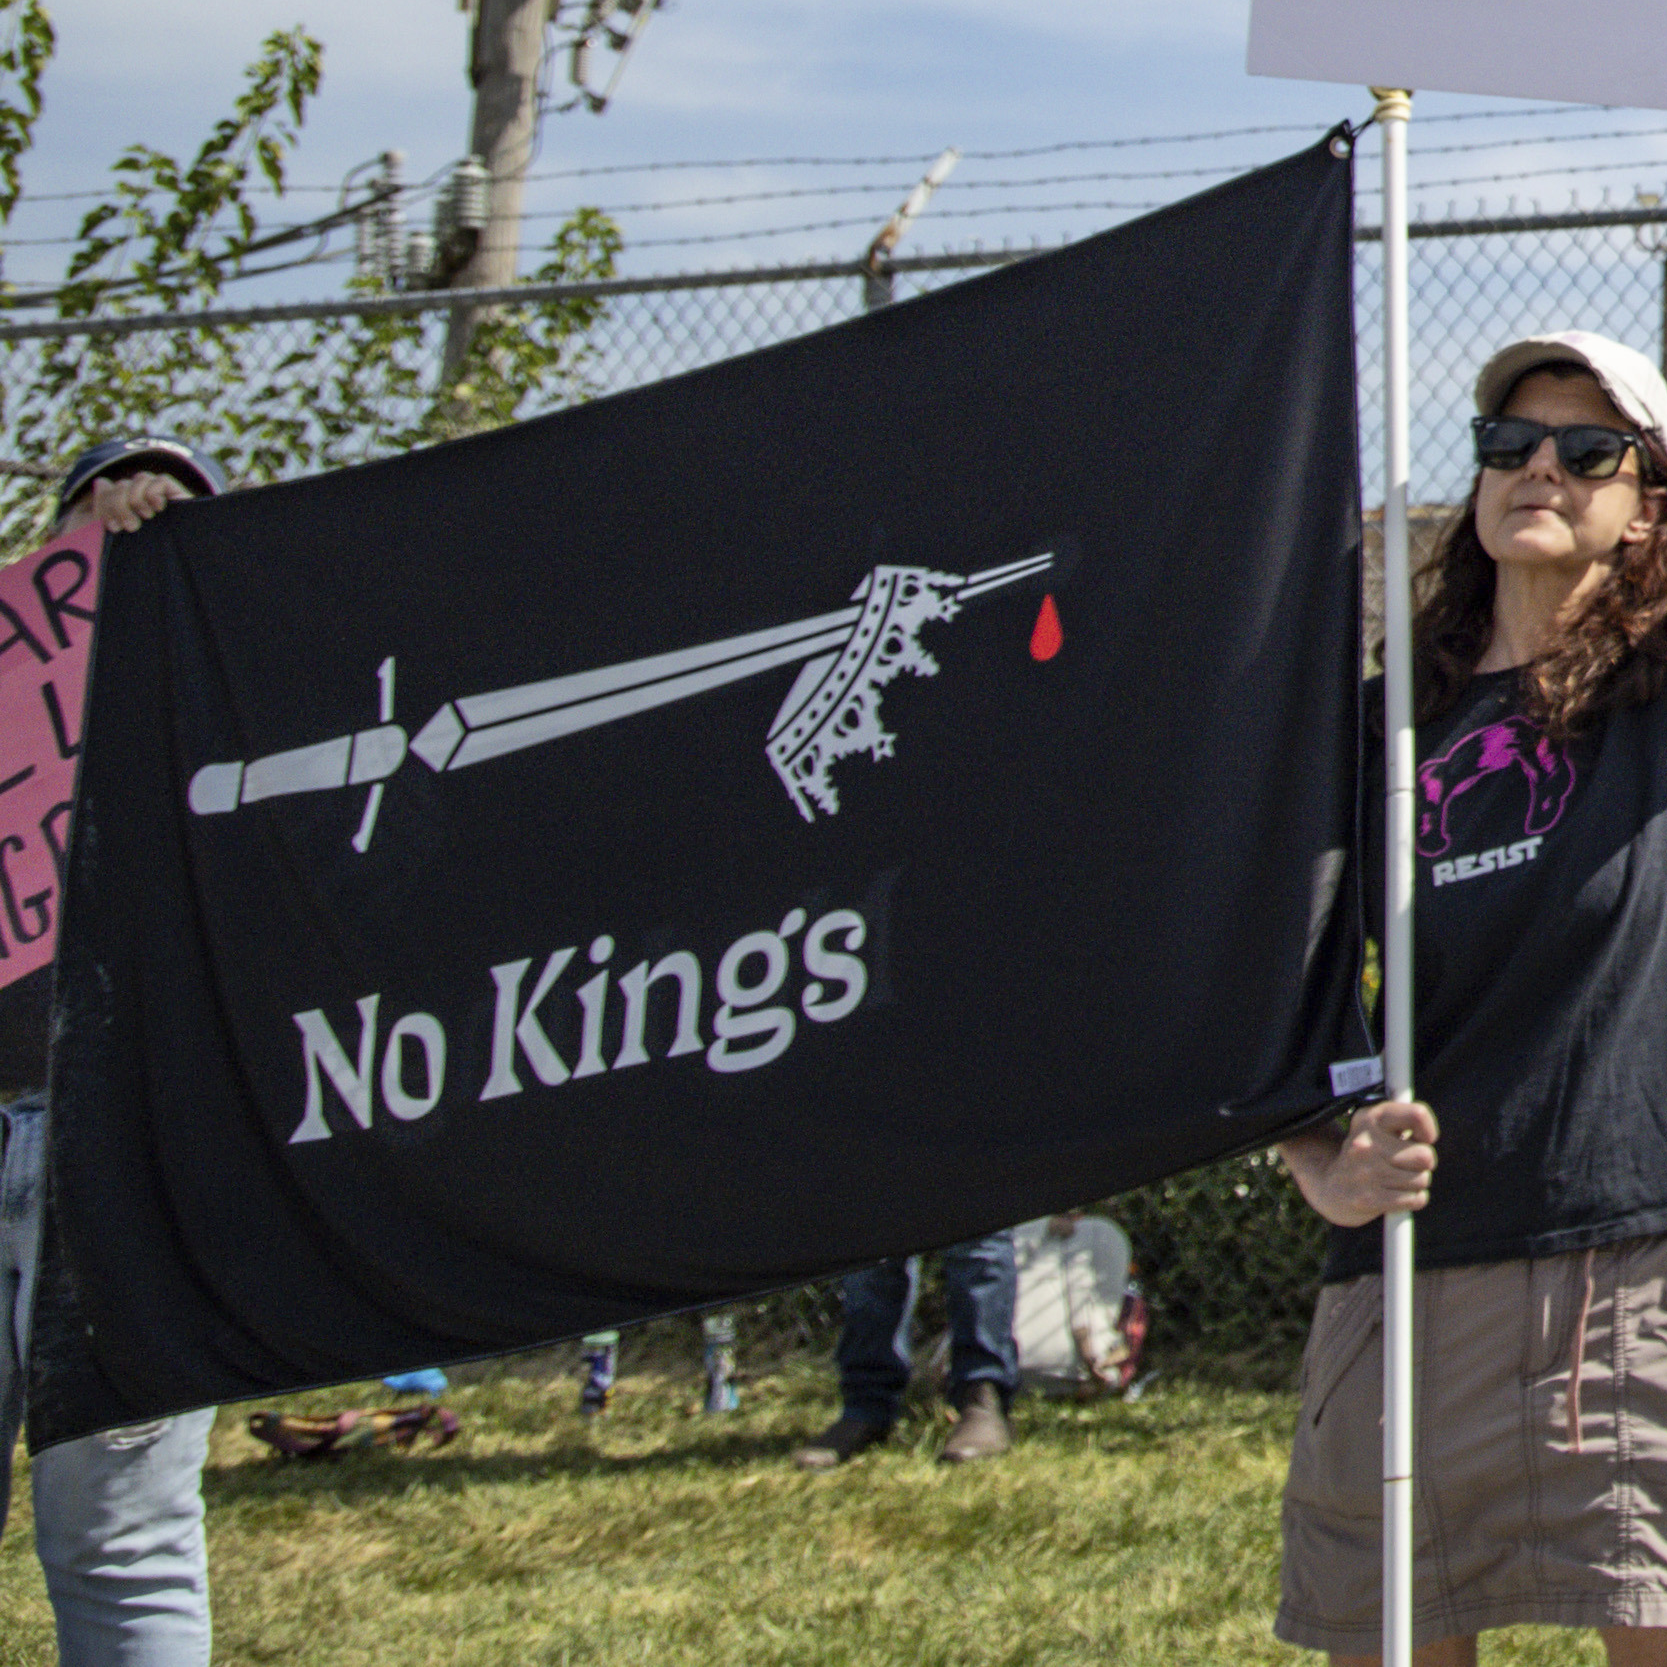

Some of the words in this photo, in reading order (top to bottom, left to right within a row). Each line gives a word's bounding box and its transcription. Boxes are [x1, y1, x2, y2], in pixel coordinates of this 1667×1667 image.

[1432, 835, 1543, 887] RESIST
[288, 993, 446, 1145] No
[479, 907, 868, 1101] Kings
